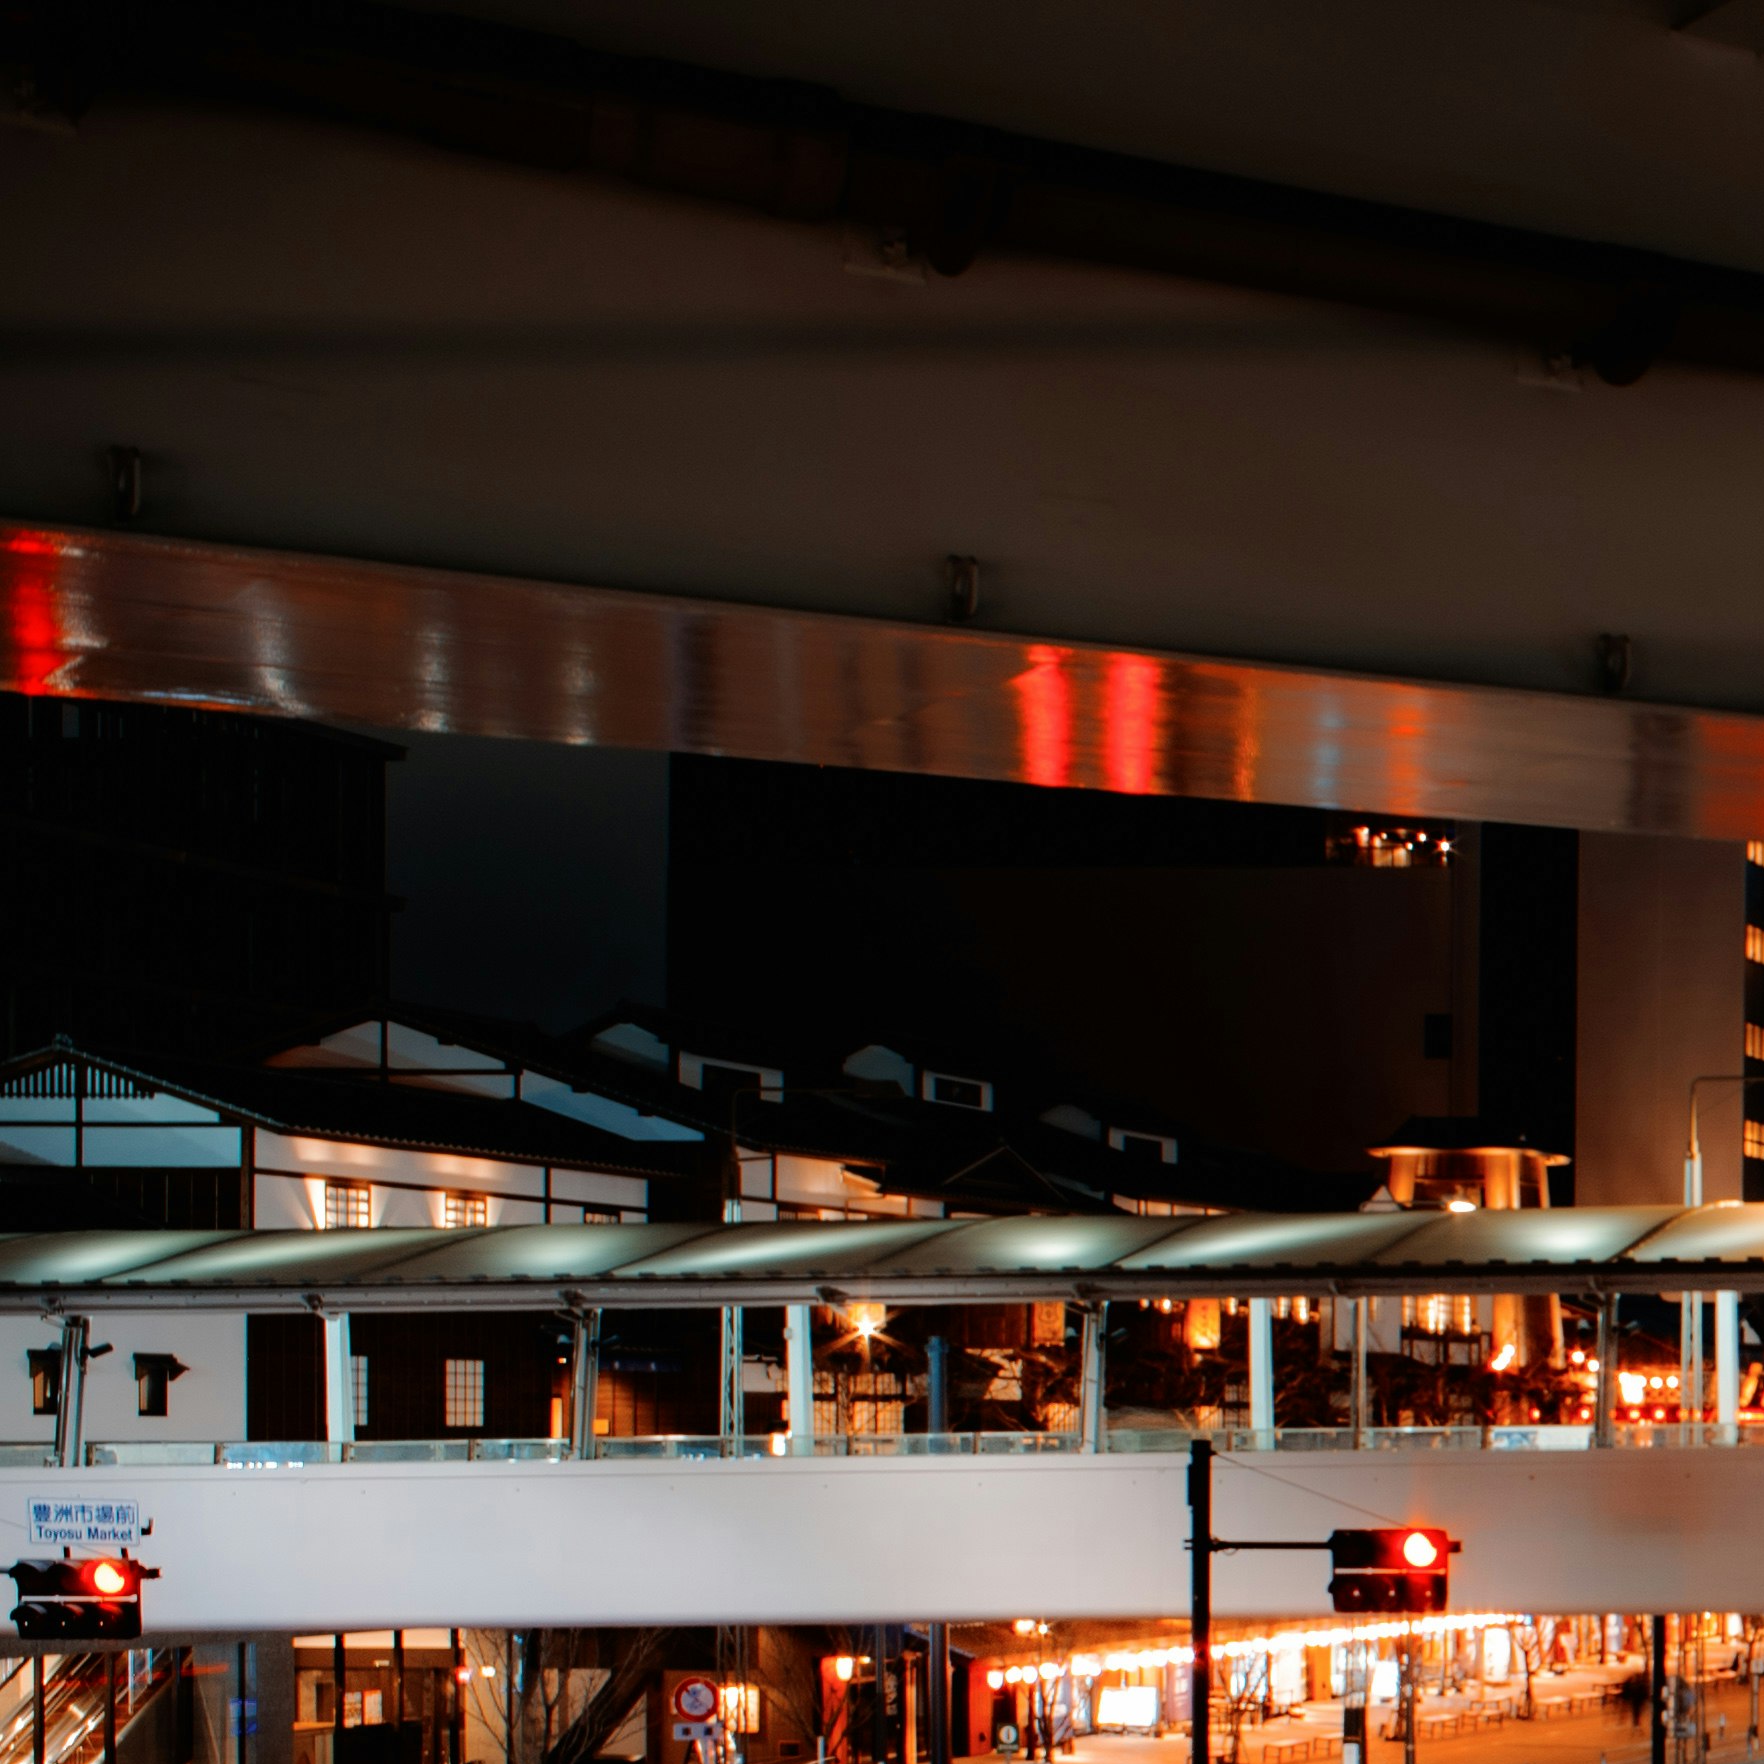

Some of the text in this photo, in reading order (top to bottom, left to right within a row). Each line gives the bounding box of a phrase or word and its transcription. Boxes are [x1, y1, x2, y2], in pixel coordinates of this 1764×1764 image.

[33, 1503, 135, 1525] 豊洲市場前
[37, 1525, 133, 1543] Toyosu Market
